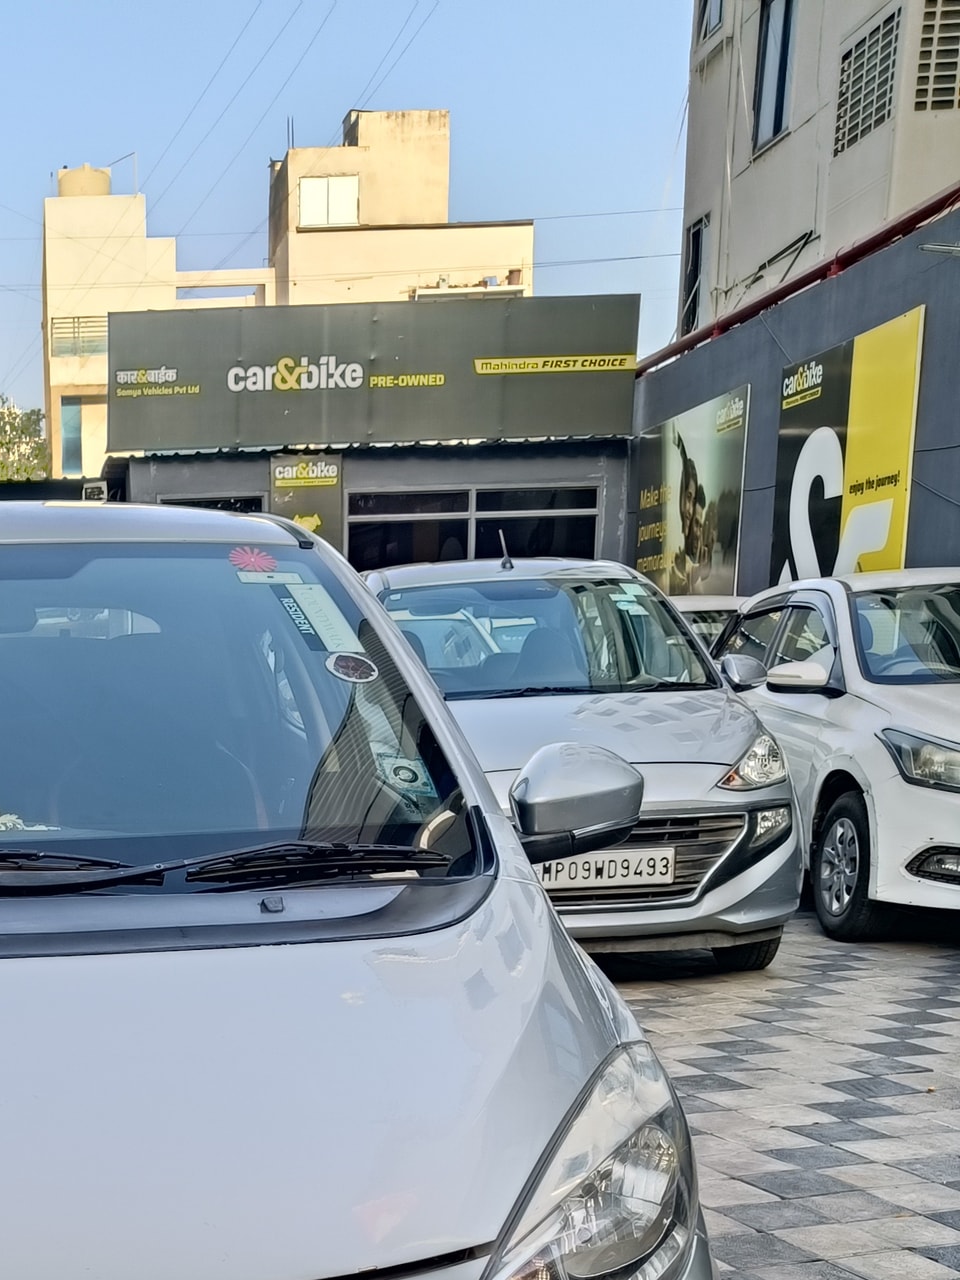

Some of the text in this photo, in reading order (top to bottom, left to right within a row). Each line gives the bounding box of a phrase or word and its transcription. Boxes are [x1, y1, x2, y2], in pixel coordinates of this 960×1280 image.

[227, 355, 364, 392] car&bike
[481, 358, 627, 371] Mahindra FIRST CHOICE
[369, 373, 446, 388] PRE-OWNED
[783, 361, 823, 397] car&bike
[275, 461, 338, 479] car&bike
[280, 597, 315, 636] RESIDENT
